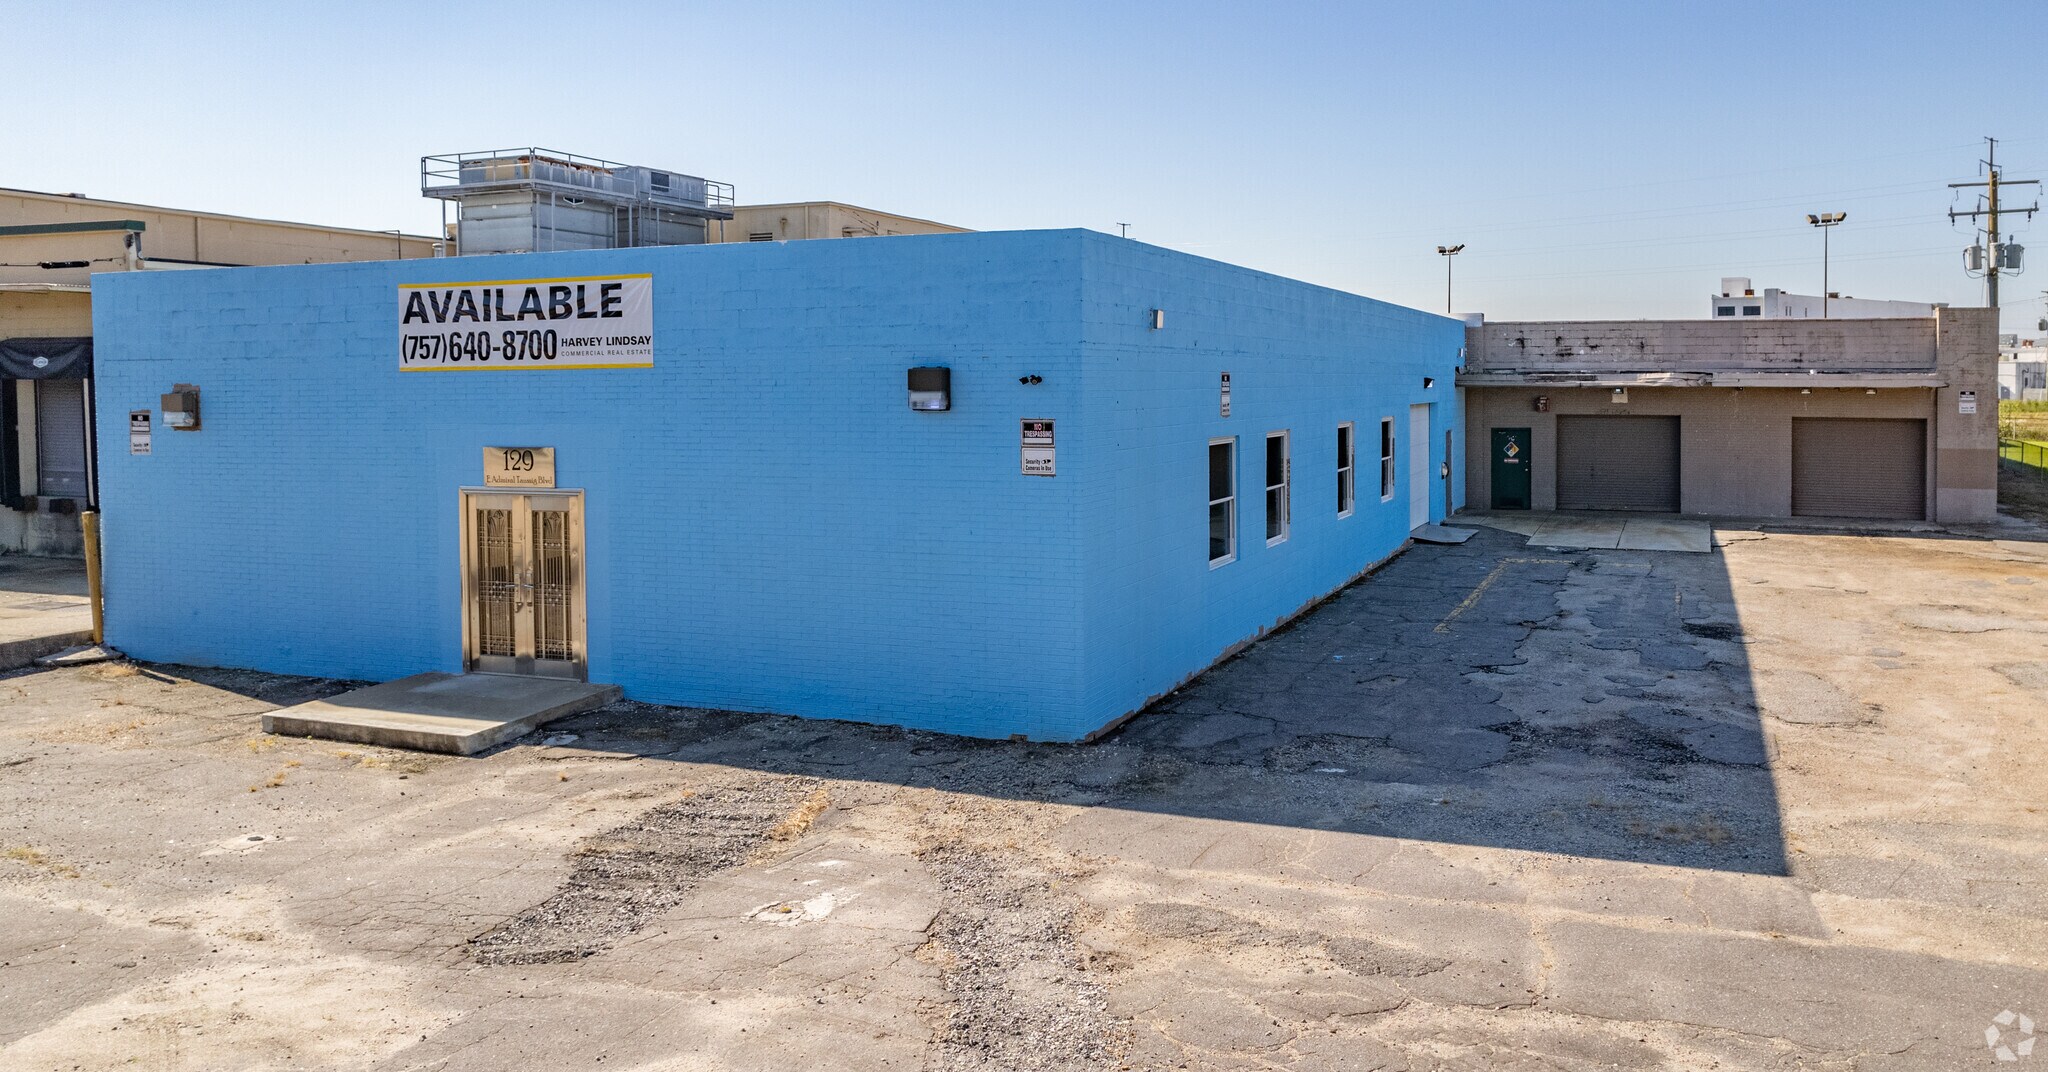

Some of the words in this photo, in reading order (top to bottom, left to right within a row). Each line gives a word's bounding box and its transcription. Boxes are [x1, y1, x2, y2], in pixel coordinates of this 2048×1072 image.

[402, 282, 623, 325] AVAILABLE
[561, 337, 603, 347] HARVEY
[606, 335, 652, 346] LINDSAY
[1033, 423, 1043, 431] NO
[1024, 430, 1052, 438] TRESPASSING
[503, 449, 534, 471] 129
[486, 475, 491, 483] E
[492, 475, 516, 484] Admiral
[538, 475, 553, 484] Blvd
